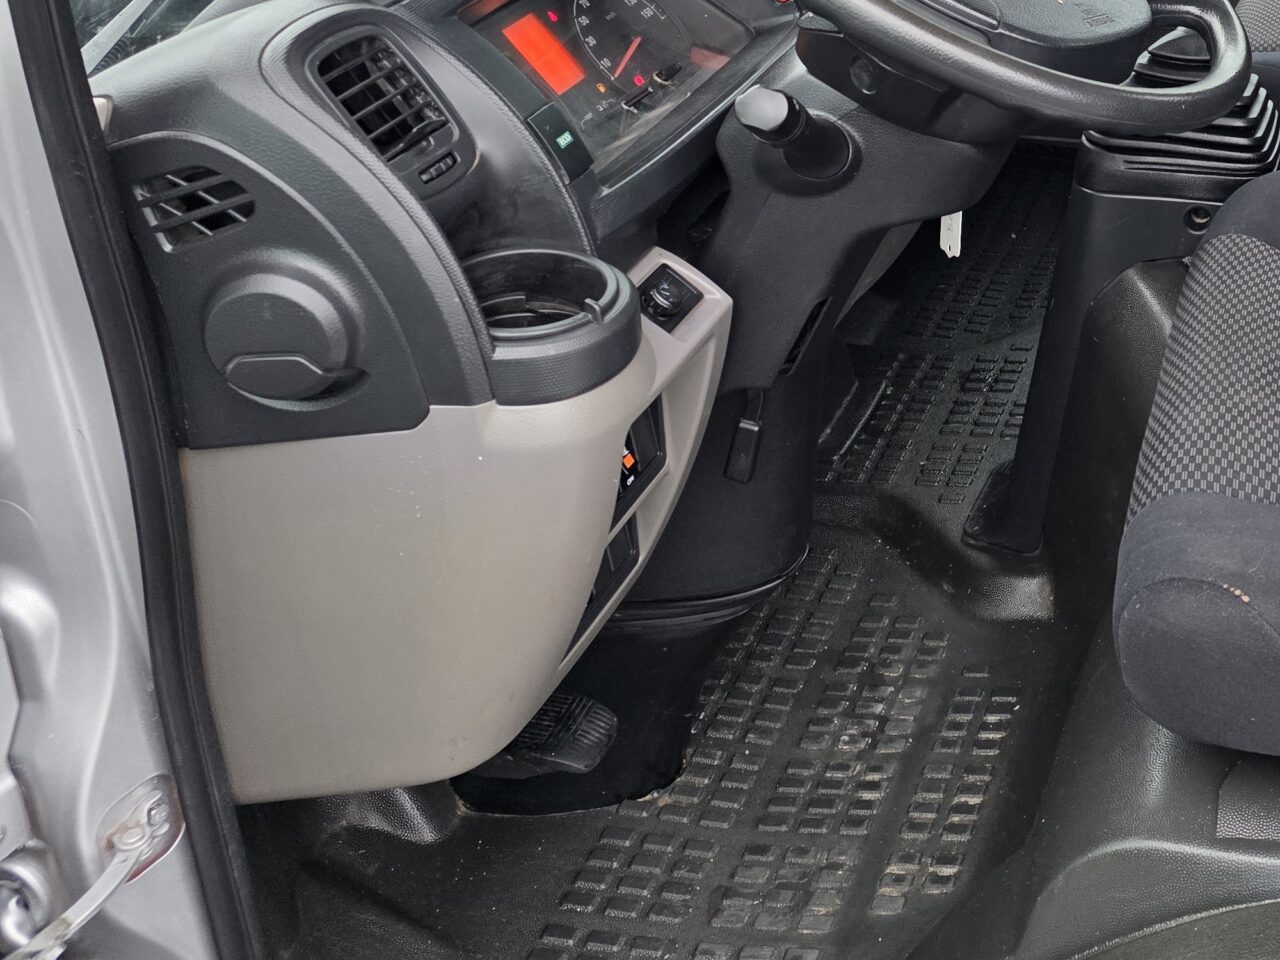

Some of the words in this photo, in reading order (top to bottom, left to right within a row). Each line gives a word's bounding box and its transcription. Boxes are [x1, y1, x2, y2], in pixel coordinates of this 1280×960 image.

[640, 7, 654, 20] 150
[578, 15, 590, 27] 50
[585, 35, 597, 47] 30
[600, 57, 612, 69] 10
